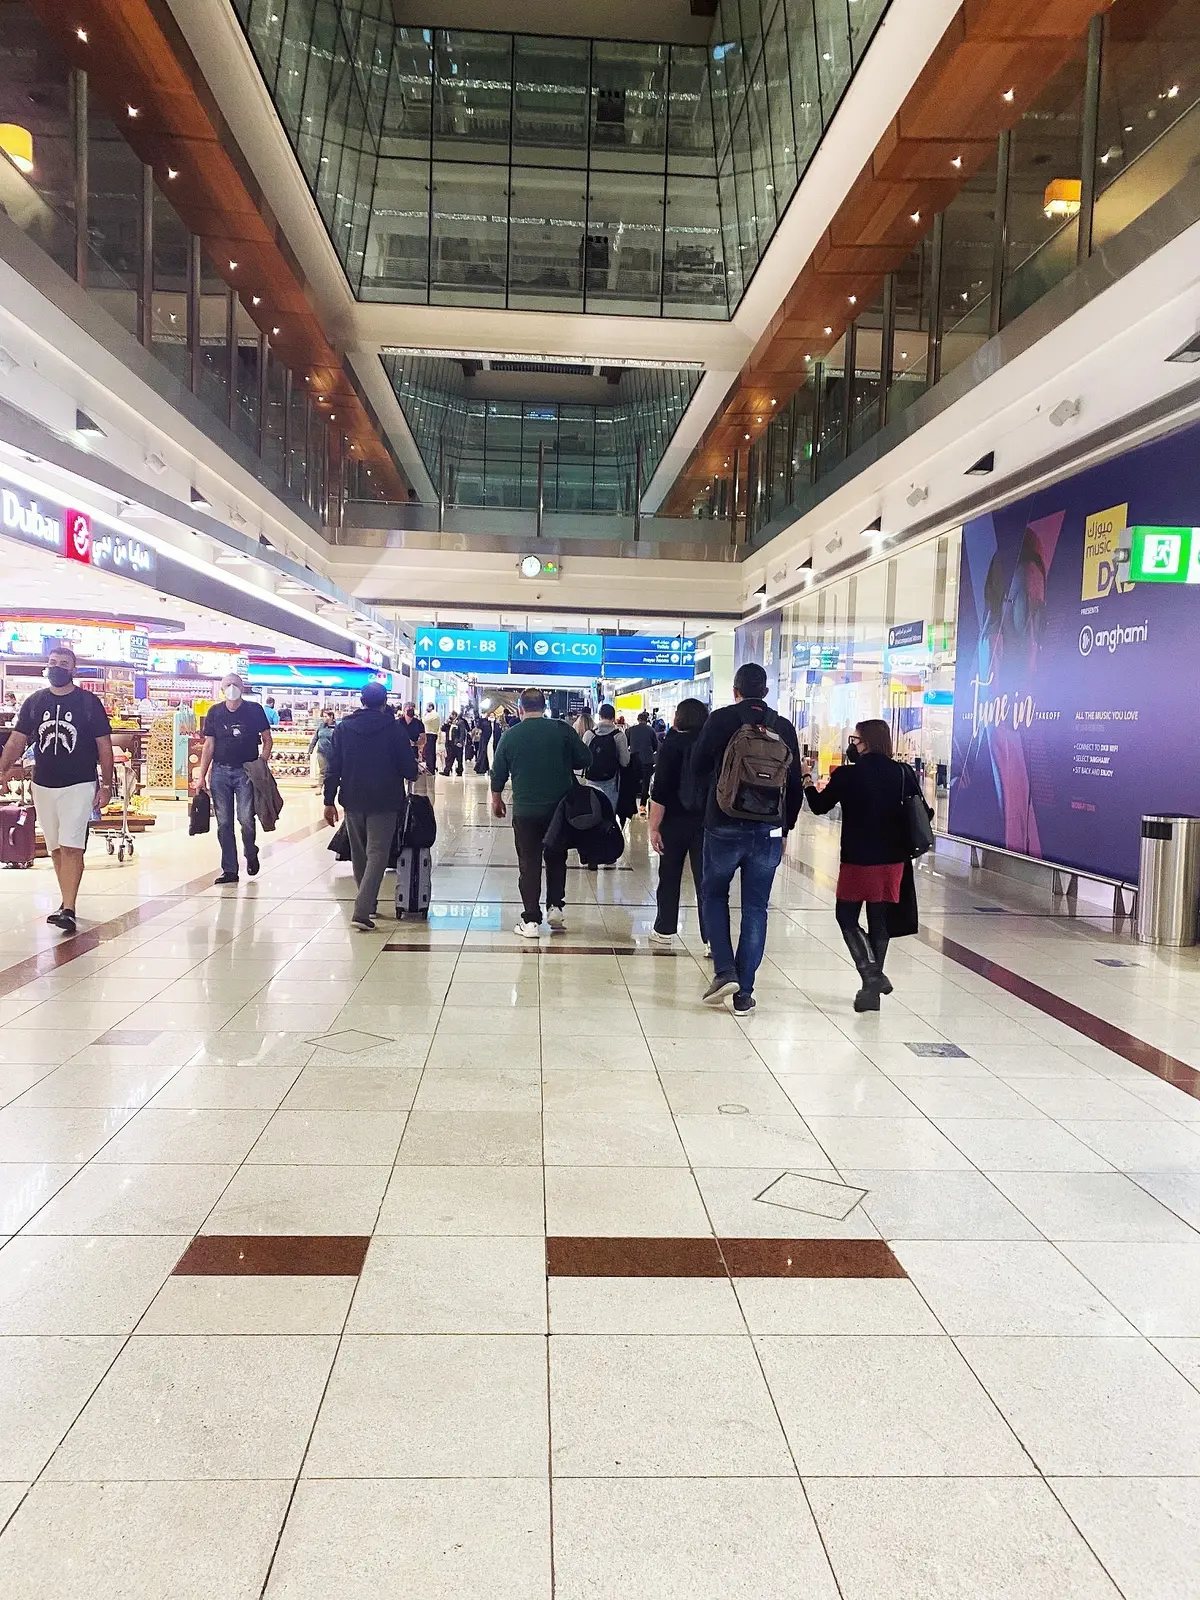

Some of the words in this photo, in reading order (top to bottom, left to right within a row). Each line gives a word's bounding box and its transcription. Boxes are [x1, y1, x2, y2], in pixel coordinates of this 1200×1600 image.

[1086, 540, 1112, 558] music
[1097, 561, 1136, 594] DX
[1095, 619, 1148, 653] anghami
[551, 642, 597, 656] C1-C50
[1013, 691, 1036, 730] in
[1035, 711, 1061, 720] TAKEOFF
[1075, 711, 1085, 720] ALL
[1085, 711, 1095, 720] THE
[1095, 711, 1112, 720] MUSIC
[1112, 711, 1124, 720] YOU
[1124, 711, 1139, 720] LOVE
